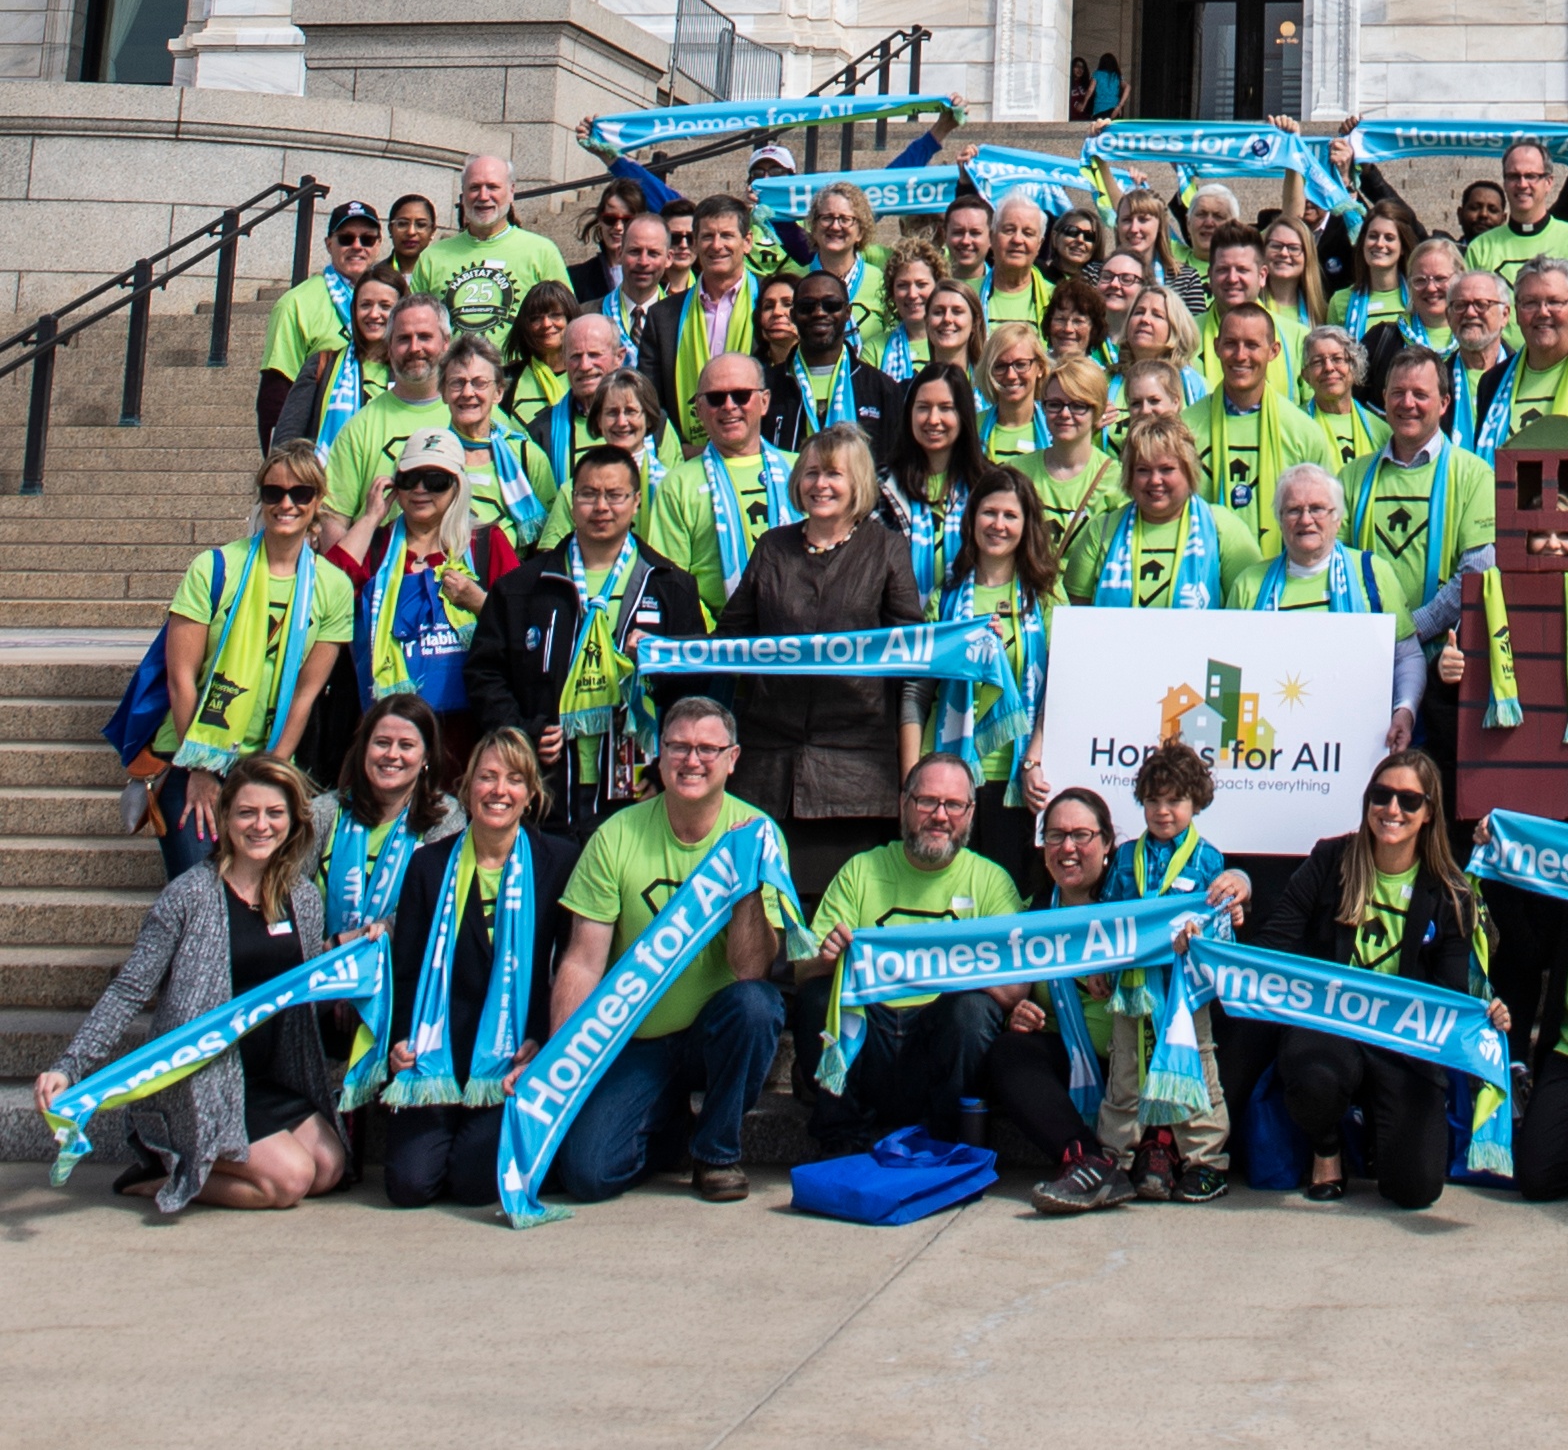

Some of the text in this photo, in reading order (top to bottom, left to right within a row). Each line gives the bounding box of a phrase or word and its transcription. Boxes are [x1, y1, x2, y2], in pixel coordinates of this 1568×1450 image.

[653, 102, 855, 135] Homes for All
[1097, 132, 1185, 153] omes
[1191, 129, 1237, 156] for
[1394, 127, 1504, 148] Homes
[906, 176, 949, 204] for
[451, 269, 510, 290] HABITAT 500
[464, 282, 493, 303] 25
[650, 626, 935, 665] Homes for All
[207, 698, 224, 711] All
[1232, 740, 1284, 771] for
[1291, 742, 1342, 773] All
[1258, 778, 1331, 795] everything
[850, 916, 1138, 988] Homes for All
[517, 846, 741, 1125] Homes for All
[1323, 979, 1390, 1027] for
[1392, 998, 1459, 1047] All
